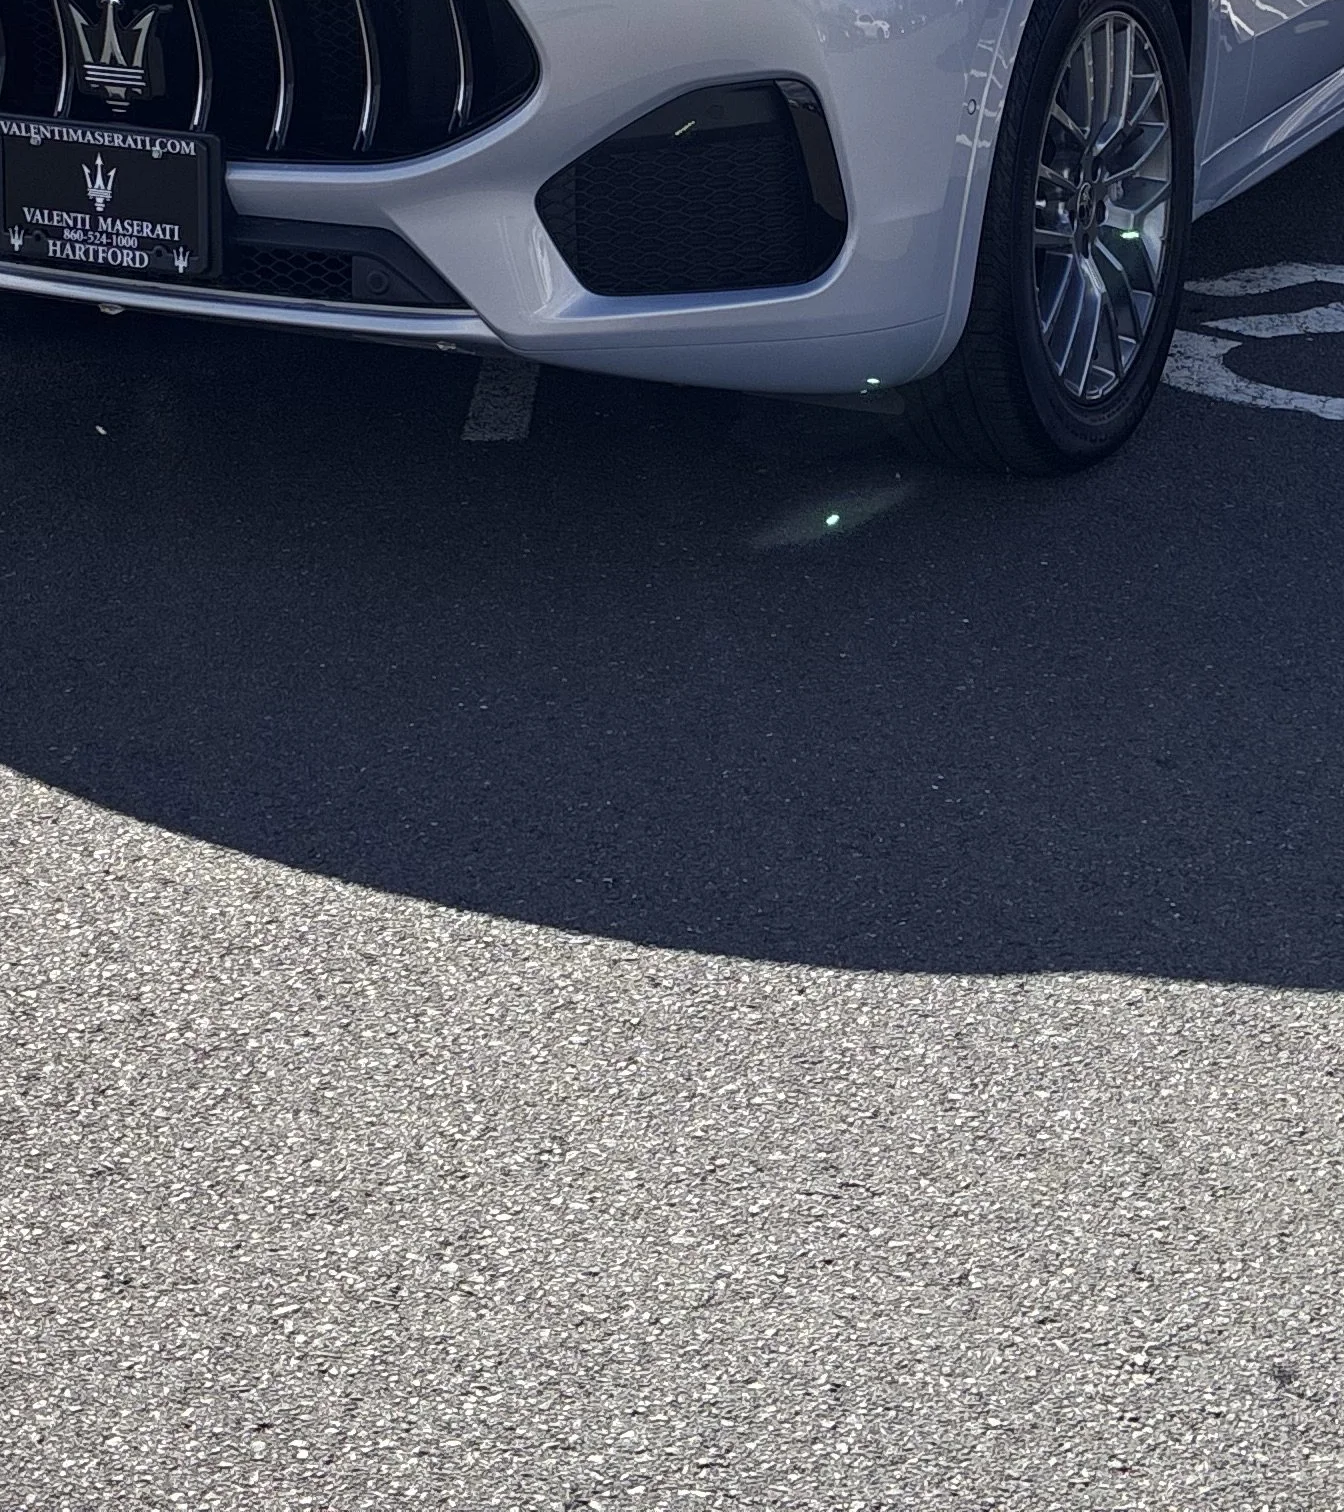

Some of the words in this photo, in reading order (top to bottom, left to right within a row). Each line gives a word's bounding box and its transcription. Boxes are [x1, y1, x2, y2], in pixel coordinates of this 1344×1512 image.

[0, 120, 197, 156] VALENTIMASERATI.COM
[22, 207, 90, 230] VALENTI
[97, 217, 180, 241] MASERATI
[63, 228, 138, 249] 860-524-1000
[47, 239, 149, 269] HARTFORD
